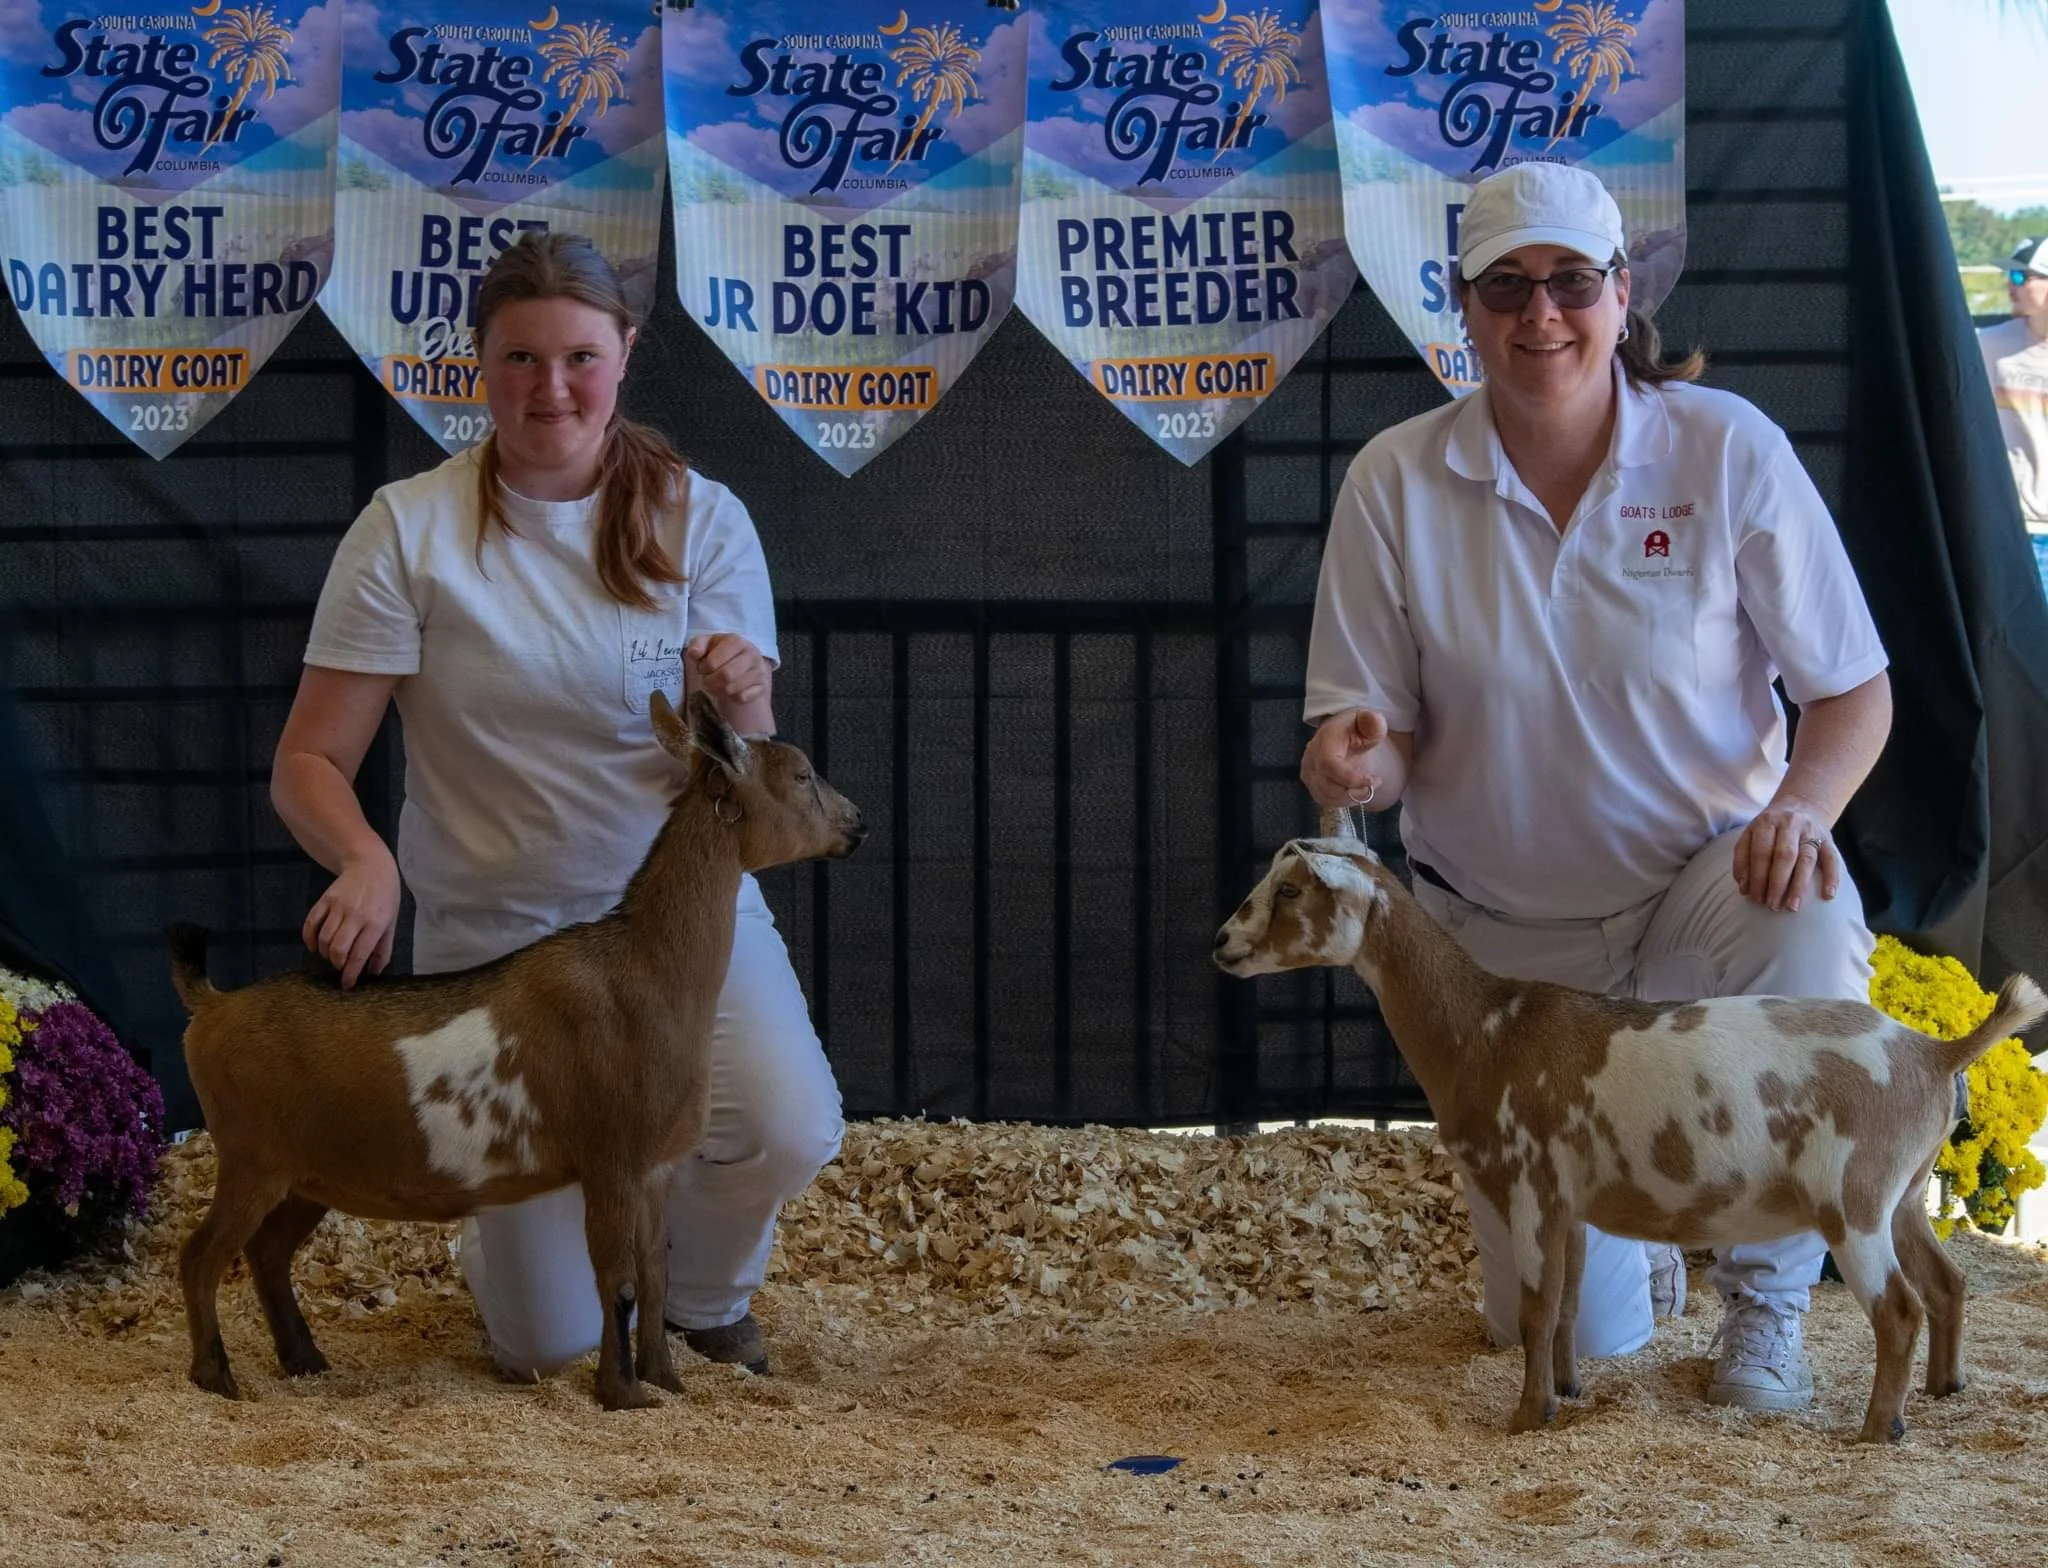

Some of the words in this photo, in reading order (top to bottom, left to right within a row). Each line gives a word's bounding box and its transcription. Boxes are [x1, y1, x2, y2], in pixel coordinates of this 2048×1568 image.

[96, 15, 136, 30] SOUTH
[138, 15, 197, 30] CAROLINA
[432, 24, 473, 40] SOUTH
[475, 26, 533, 44] CAROLINA
[1103, 26, 1143, 40] SOUTH
[1145, 24, 1203, 39] CAROLINA
[1439, 12, 1479, 27] SOUTH
[1481, 12, 1540, 27] CAROLINA
[40, 19, 199, 77] State
[373, 27, 532, 88] State
[783, 35, 822, 49] SOUTH
[825, 35, 883, 49] CAROLINA
[1384, 18, 1541, 77] State
[726, 39, 884, 96] State
[1051, 32, 1205, 90] State
[93, 75, 257, 177] Fair
[424, 85, 588, 185] Fair
[1105, 85, 1268, 186] Fair
[1439, 71, 1601, 173] Fair
[779, 94, 943, 195] Fair
[155, 160, 221, 172] COLUMBIA
[483, 171, 548, 185] COLUMBIA
[843, 179, 908, 190] COLUMBIA
[1170, 167, 1234, 180] COLUMBIA
[97, 206, 224, 259] BEST
[420, 214, 549, 270] BES
[784, 224, 911, 278] BEST
[1057, 210, 1300, 271] PREMIER
[9, 259, 168, 317] DAIRY
[184, 260, 318, 317] HERD
[703, 277, 758, 332] JR
[773, 281, 876, 336] DOE
[896, 279, 991, 335] KID
[1061, 268, 1303, 327] BREEDER
[77, 354, 164, 387] DAIRY
[172, 353, 243, 387] GOAT
[393, 361, 481, 398] DAIRY
[765, 370, 850, 404] DAIRY
[858, 372, 932, 405] GOAT
[1101, 363, 1187, 395] DAIRY
[1195, 359, 1268, 394] GOAT
[130, 405, 189, 431] 2023
[443, 414, 493, 440] 202
[817, 423, 876, 448] 2023
[1157, 413, 1215, 439] 2023
[1620, 506, 1656, 519] GOATS
[1662, 504, 1694, 519] LODGE
